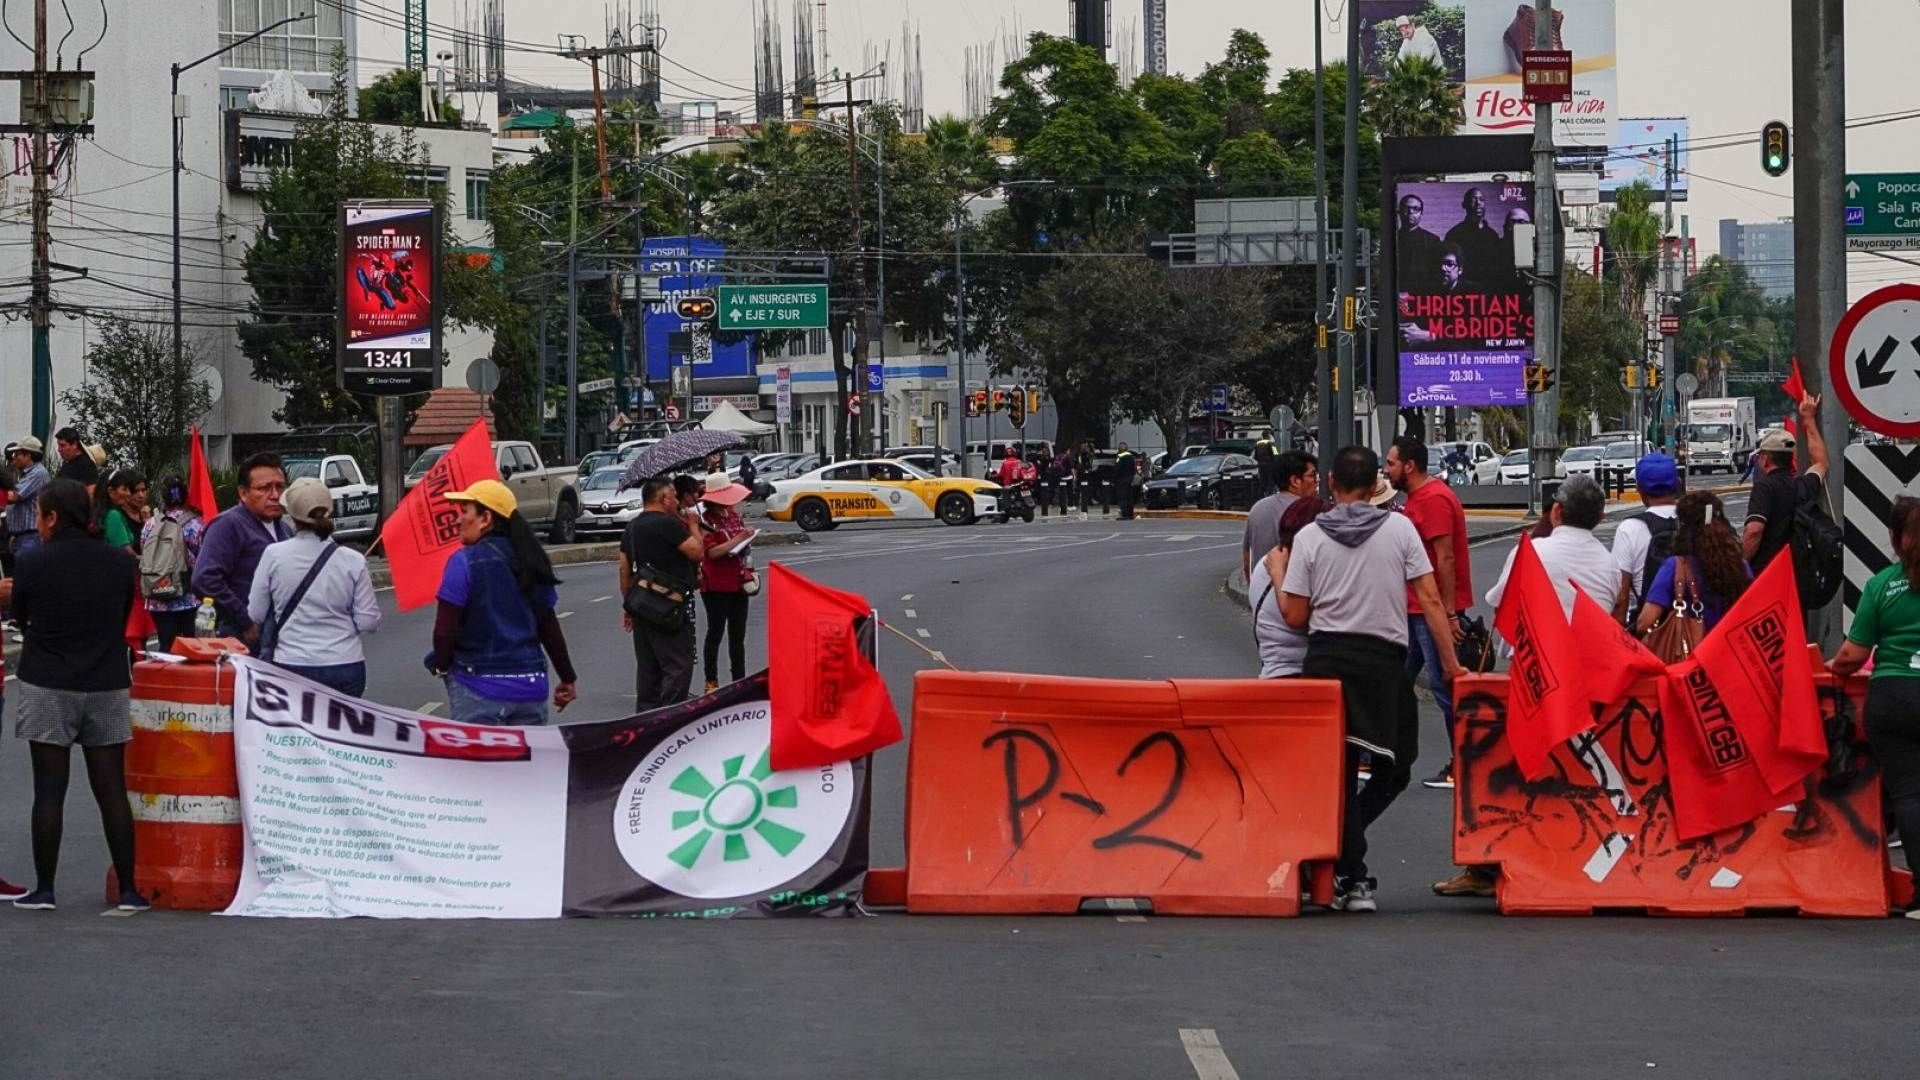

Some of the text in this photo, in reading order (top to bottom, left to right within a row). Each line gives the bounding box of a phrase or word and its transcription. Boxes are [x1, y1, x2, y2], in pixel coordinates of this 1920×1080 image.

[1476, 90, 1533, 117] flex
[1500, 187, 1523, 200] JAZZ
[1877, 181, 1920, 196] Popoc
[1877, 201, 1905, 213] Sala
[357, 235, 421, 249] SPIDER-MAN 2
[1849, 238, 1902, 250] Mayorazgo
[749, 293, 817, 304] INSURGENTES
[1399, 294, 1520, 317] CHRISTIAN
[745, 309, 800, 320] EJE 7 SUR
[1485, 339, 1526, 347] NEW JAWN
[364, 351, 411, 368] 13:41
[1413, 352, 1520, 366] Sábado 11 de noviembre
[1448, 370, 1485, 382] 20:30 h.
[1407, 392, 1458, 404] CANTORAL
[829, 497, 877, 510] TRANSITO
[265, 732, 398, 769] NUESTRAS DEMANDAS:
[266, 750, 327, 768] Recuperación
[629, 787, 646, 834] FRENTE
[640, 733, 695, 784] SINDICAL
[696, 709, 766, 735] UNITARIO
[282, 771, 294, 781] de
[295, 774, 335, 784] aumento
[386, 789, 426, 802] Revisión
[981, 728, 1203, 861] P-2
[284, 790, 297, 800] de
[298, 793, 365, 806] fortalecimiento
[377, 803, 406, 817] salario
[408, 810, 426, 822] que
[427, 812, 437, 820] el
[437, 814, 487, 825] presidente
[288, 801, 321, 815] Manuel
[323, 804, 349, 818] López
[351, 806, 388, 822] Obrador
[259, 815, 321, 835] Cumplimiento
[331, 826, 341, 835] la
[342, 828, 395, 840] disposición
[396, 834, 451, 850] presidencial
[453, 840, 466, 850] de
[467, 841, 501, 853] igualar
[267, 828, 302, 843] salarios
[304, 836, 316, 845] de
[319, 837, 333, 845] los
[335, 837, 392, 851] trabajadores
[394, 842, 406, 851] de
[407, 844, 417, 853] la
[418, 848, 466, 861] educación
[475, 853, 503, 863] ganar
[300, 847, 312, 856] de
[313, 847, 320, 858] $
[366, 853, 394, 863] pesos
[332, 867, 378, 881] Unificada
[379, 873, 391, 881] en
[392, 873, 402, 882] el
[403, 874, 424, 884] mes
[425, 876, 437, 884] de
[438, 875, 489, 889] Noviembre
[489, 879, 512, 890] para
